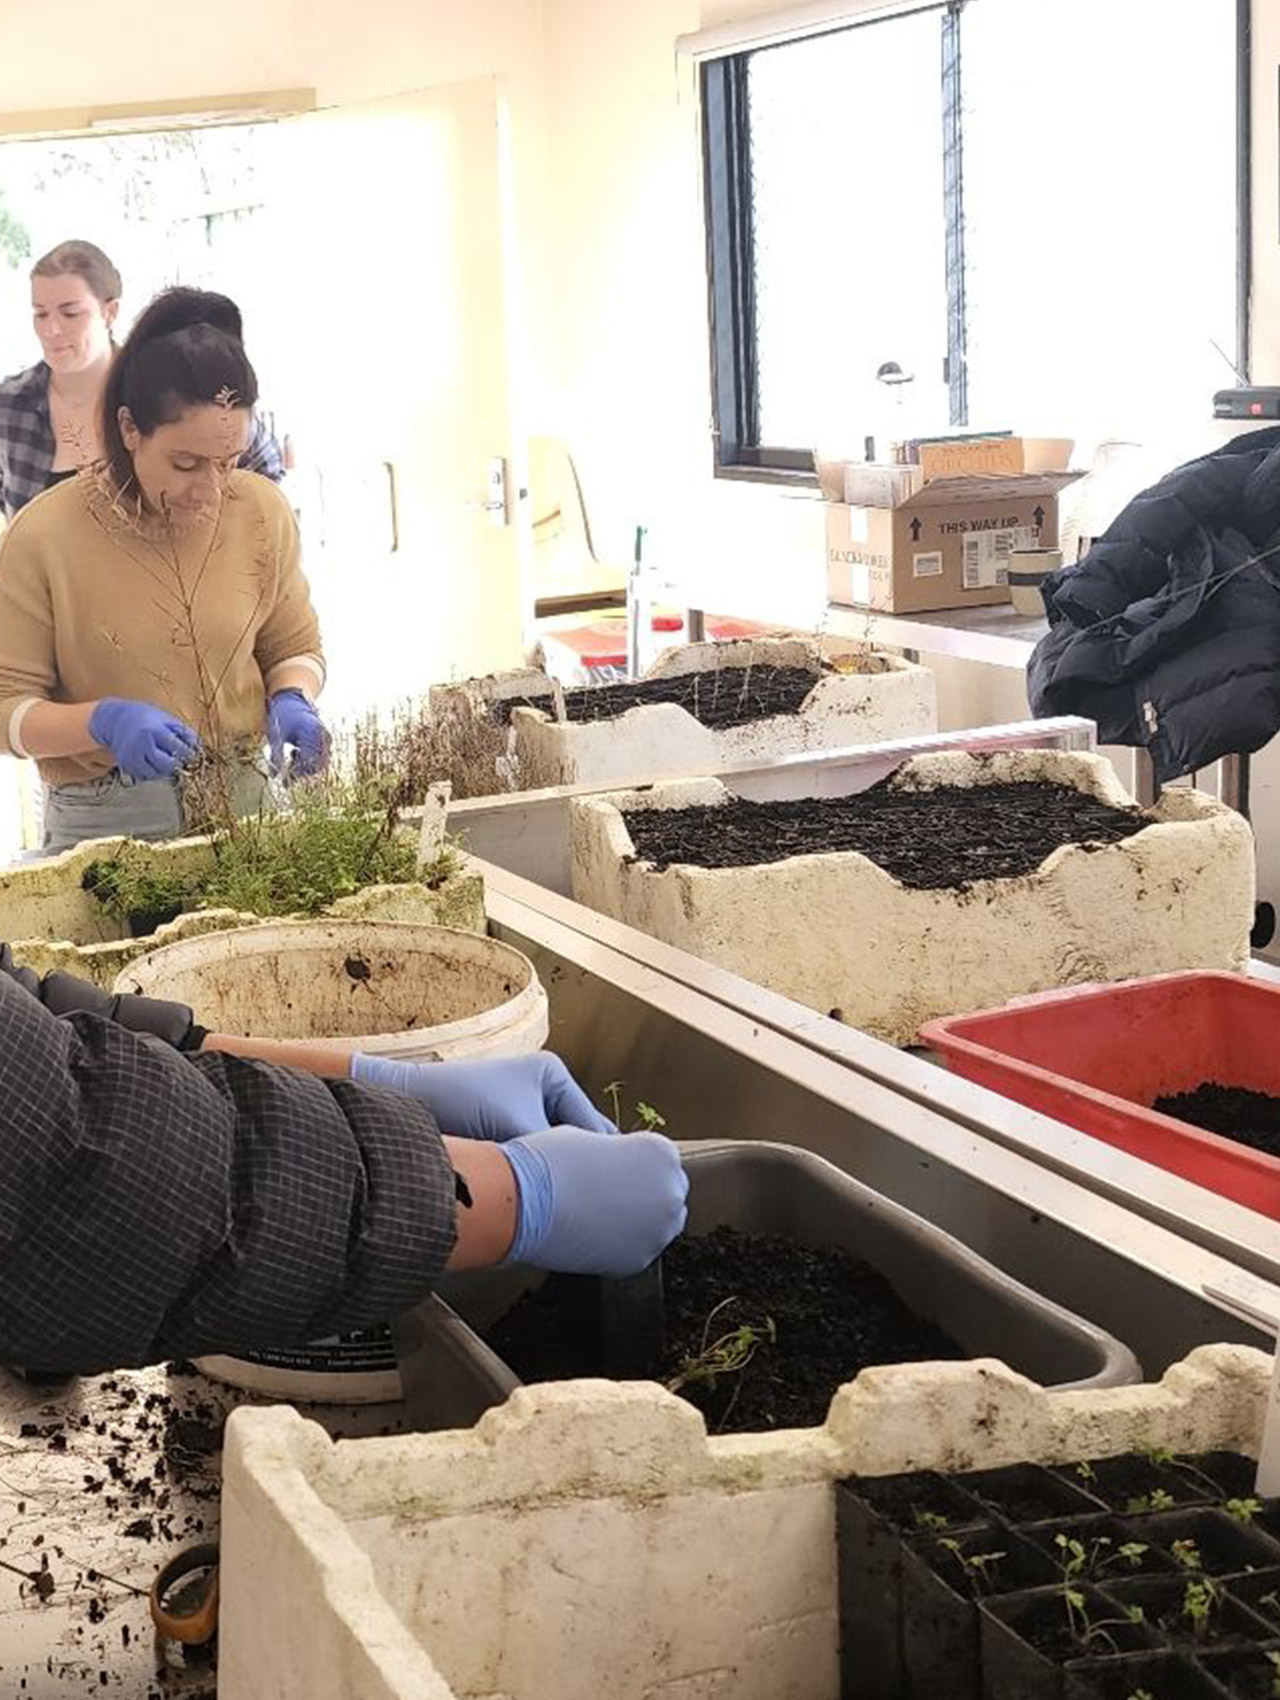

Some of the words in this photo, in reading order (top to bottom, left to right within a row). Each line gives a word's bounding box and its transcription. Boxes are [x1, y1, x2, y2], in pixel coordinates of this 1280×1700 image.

[938, 520, 968, 534] THIS
[970, 518, 999, 531] WAY
[1000, 516, 1020, 529] UP
